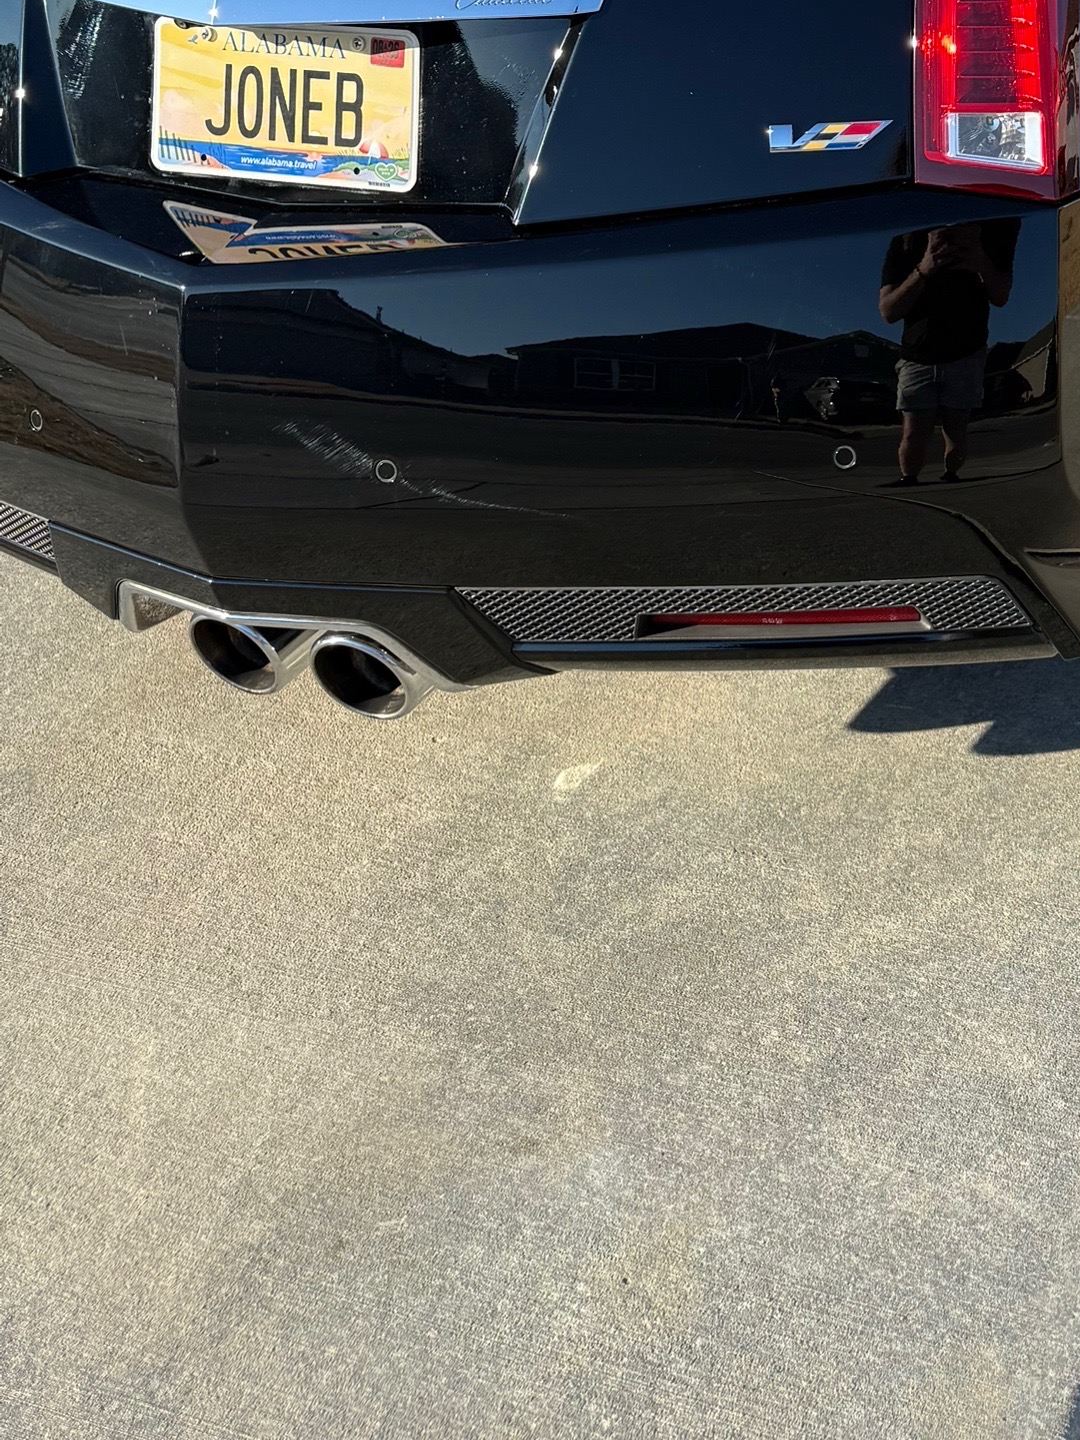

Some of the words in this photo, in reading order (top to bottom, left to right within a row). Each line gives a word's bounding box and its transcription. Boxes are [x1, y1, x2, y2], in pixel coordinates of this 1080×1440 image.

[223, 30, 346, 59] ALABAMA
[205, 63, 363, 148] JONEB
[240, 154, 317, 170] www.alabama.travel
